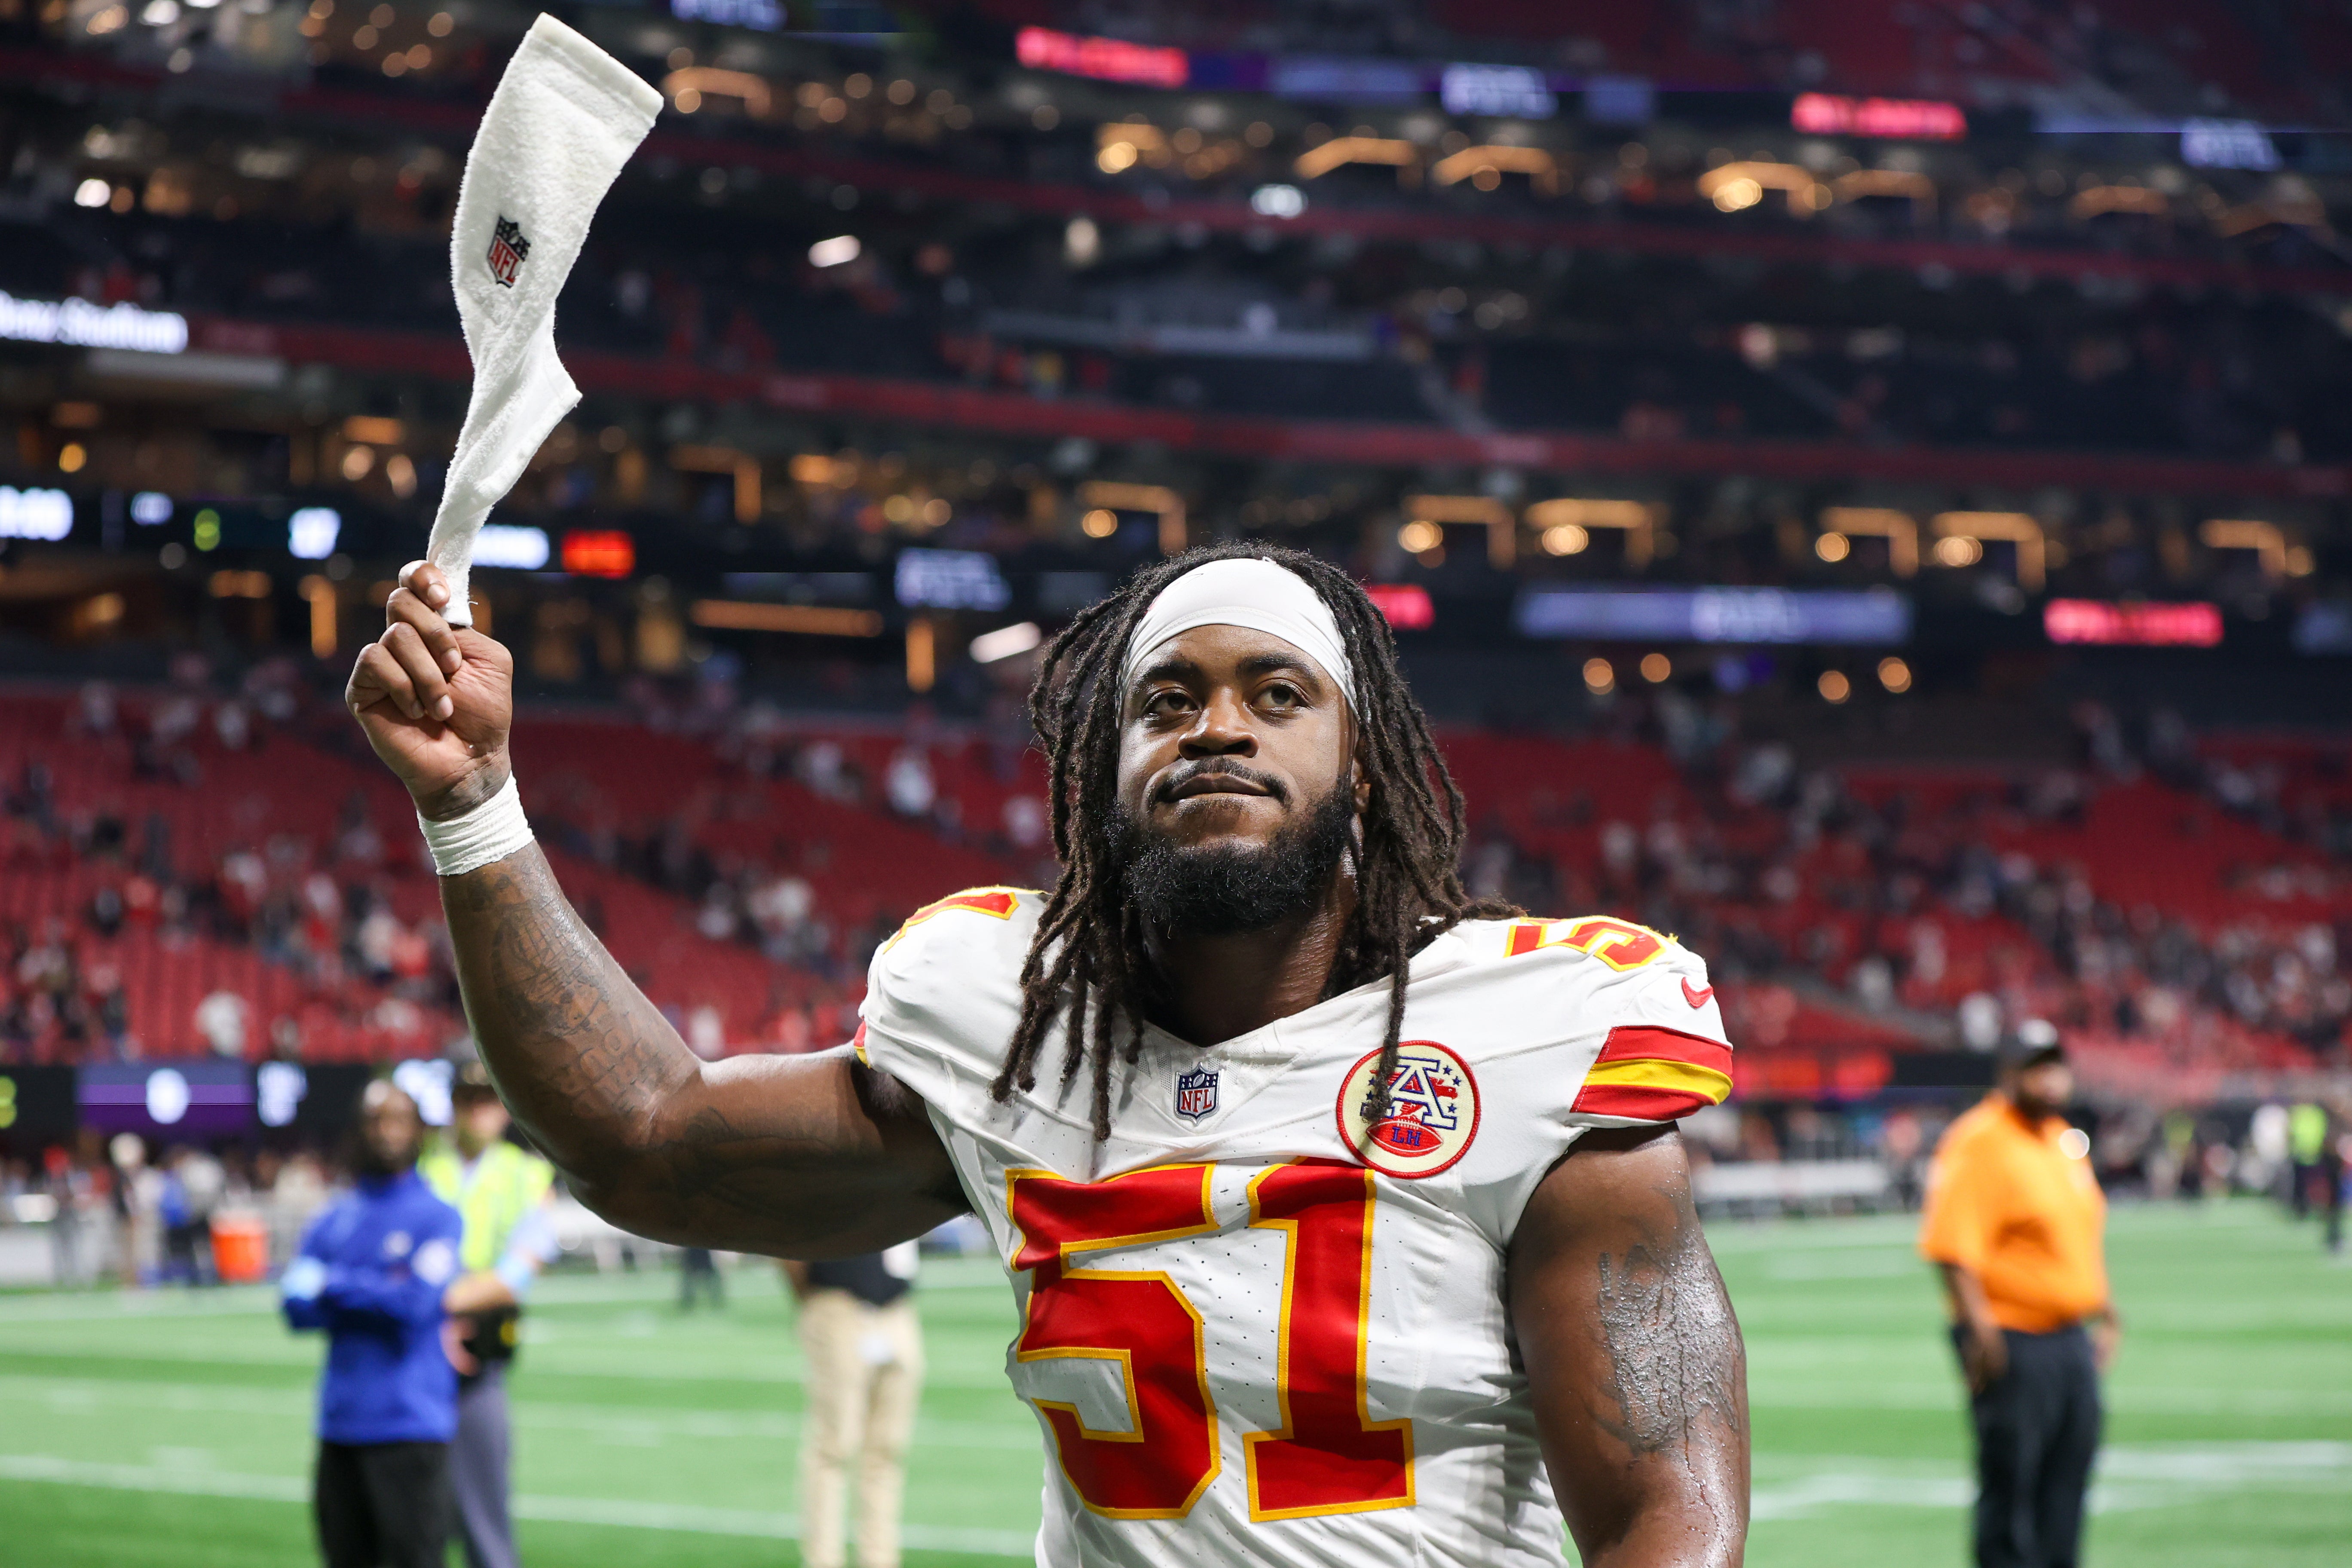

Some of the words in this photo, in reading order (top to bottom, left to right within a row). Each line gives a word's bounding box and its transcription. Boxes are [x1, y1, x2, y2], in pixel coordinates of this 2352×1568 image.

[489, 239, 519, 284] NFL
[1181, 1089, 1212, 1113] NFL
[1360, 1056, 1458, 1130] A
[1390, 1126, 1421, 1146] LH
[1005, 1156, 1417, 1522] 51
